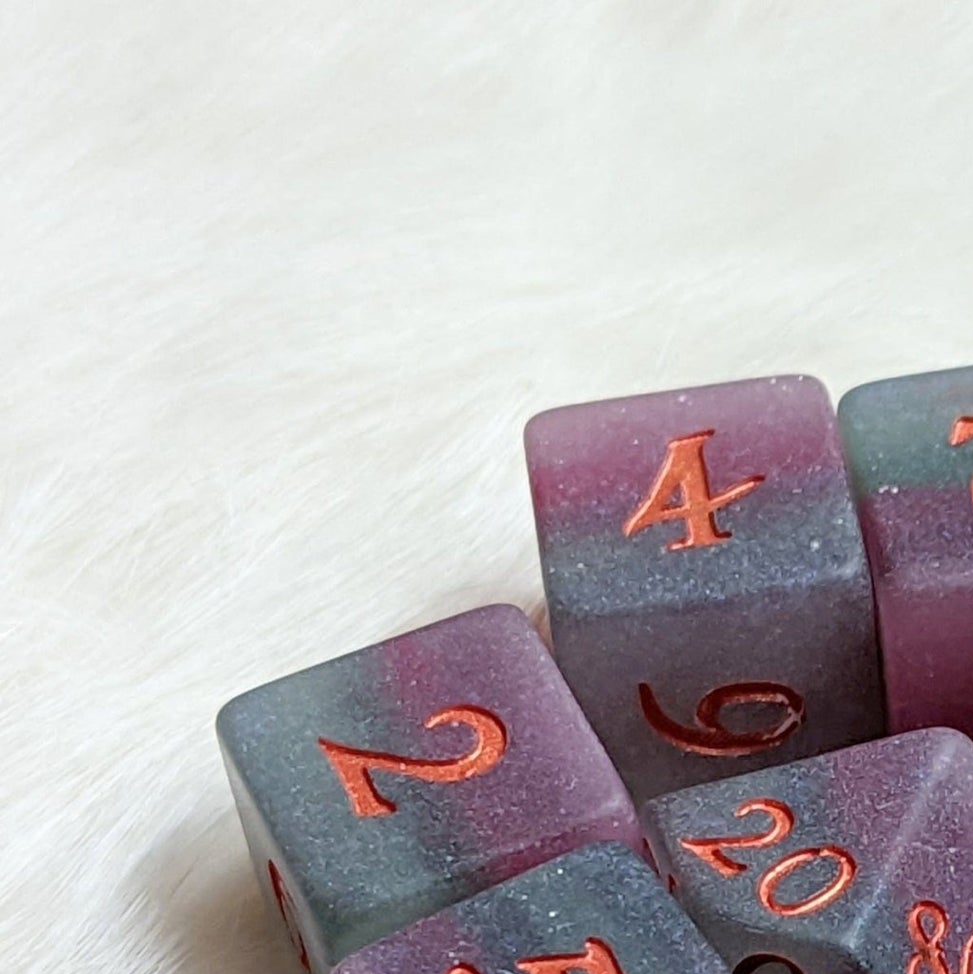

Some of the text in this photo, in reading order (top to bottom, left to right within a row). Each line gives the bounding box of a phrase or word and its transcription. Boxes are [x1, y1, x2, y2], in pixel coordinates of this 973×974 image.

[622, 428, 767, 551] 4
[316, 702, 510, 819] 2
[677, 796, 859, 917] 20
